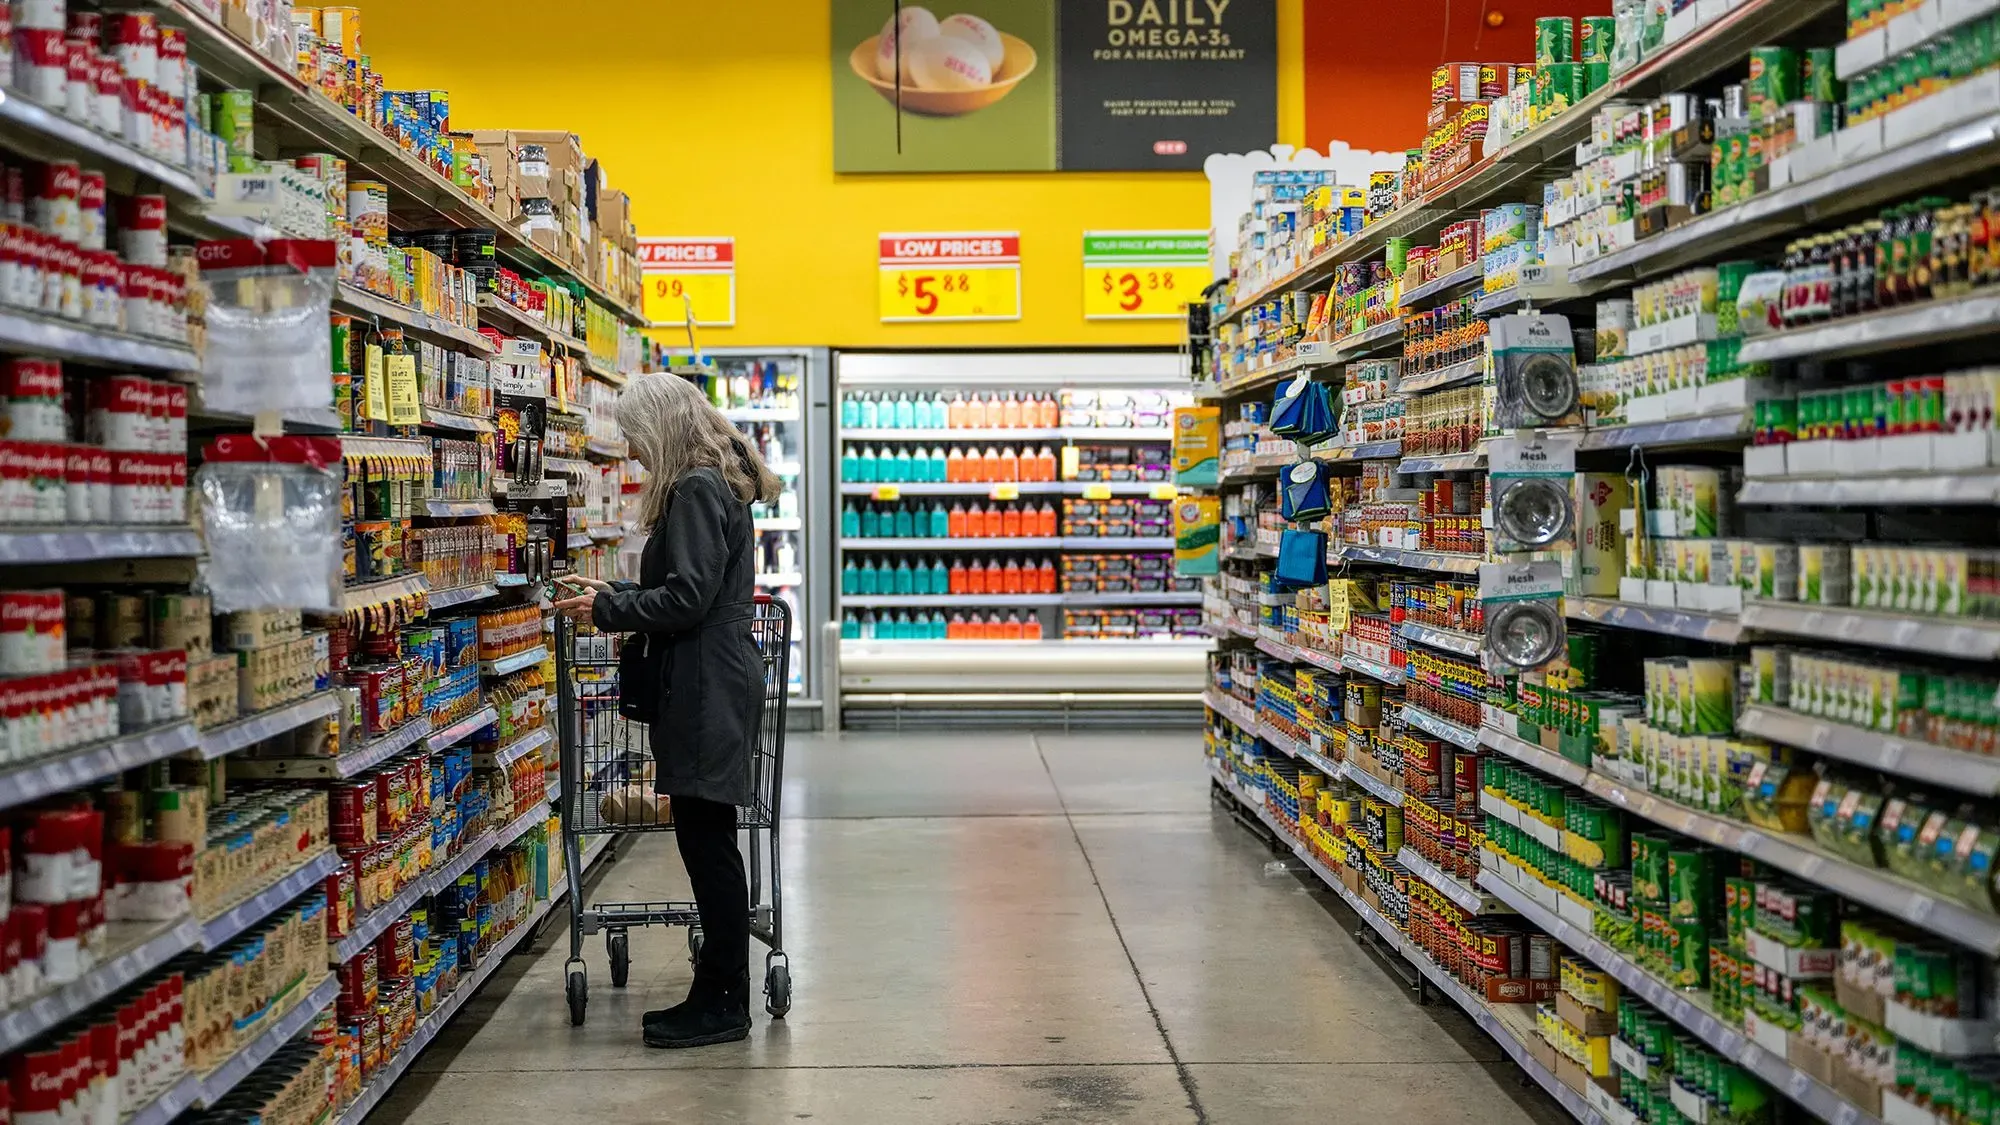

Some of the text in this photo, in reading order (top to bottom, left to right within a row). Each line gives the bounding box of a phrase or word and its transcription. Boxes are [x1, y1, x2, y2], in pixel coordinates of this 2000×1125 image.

[1108, 0, 1230, 25] DAILY
[1093, 50, 1245, 60] FOR A HEALTHY HEART
[1104, 100, 1236, 108] DAIRY PRODUCTS ARE A VITAL
[1111, 108, 1228, 116] PART OF A BALANCED DIET
[894, 239, 1004, 256] LOW PRICES
[1145, 240, 1175, 249] AFTER
[653, 245, 718, 261] PRICES
[1529, 327, 1551, 337] Mesh
[503, 382, 524, 390] simply
[1520, 452, 1547, 461] Mesh
[1504, 461, 1563, 470] Sink Strainer
[508, 485, 563, 494] simply mply
[1507, 574, 1535, 584] Mesh
[1492, 582, 1551, 595] Sink Strainer
[1500, 985, 1524, 994] BUSH'S
